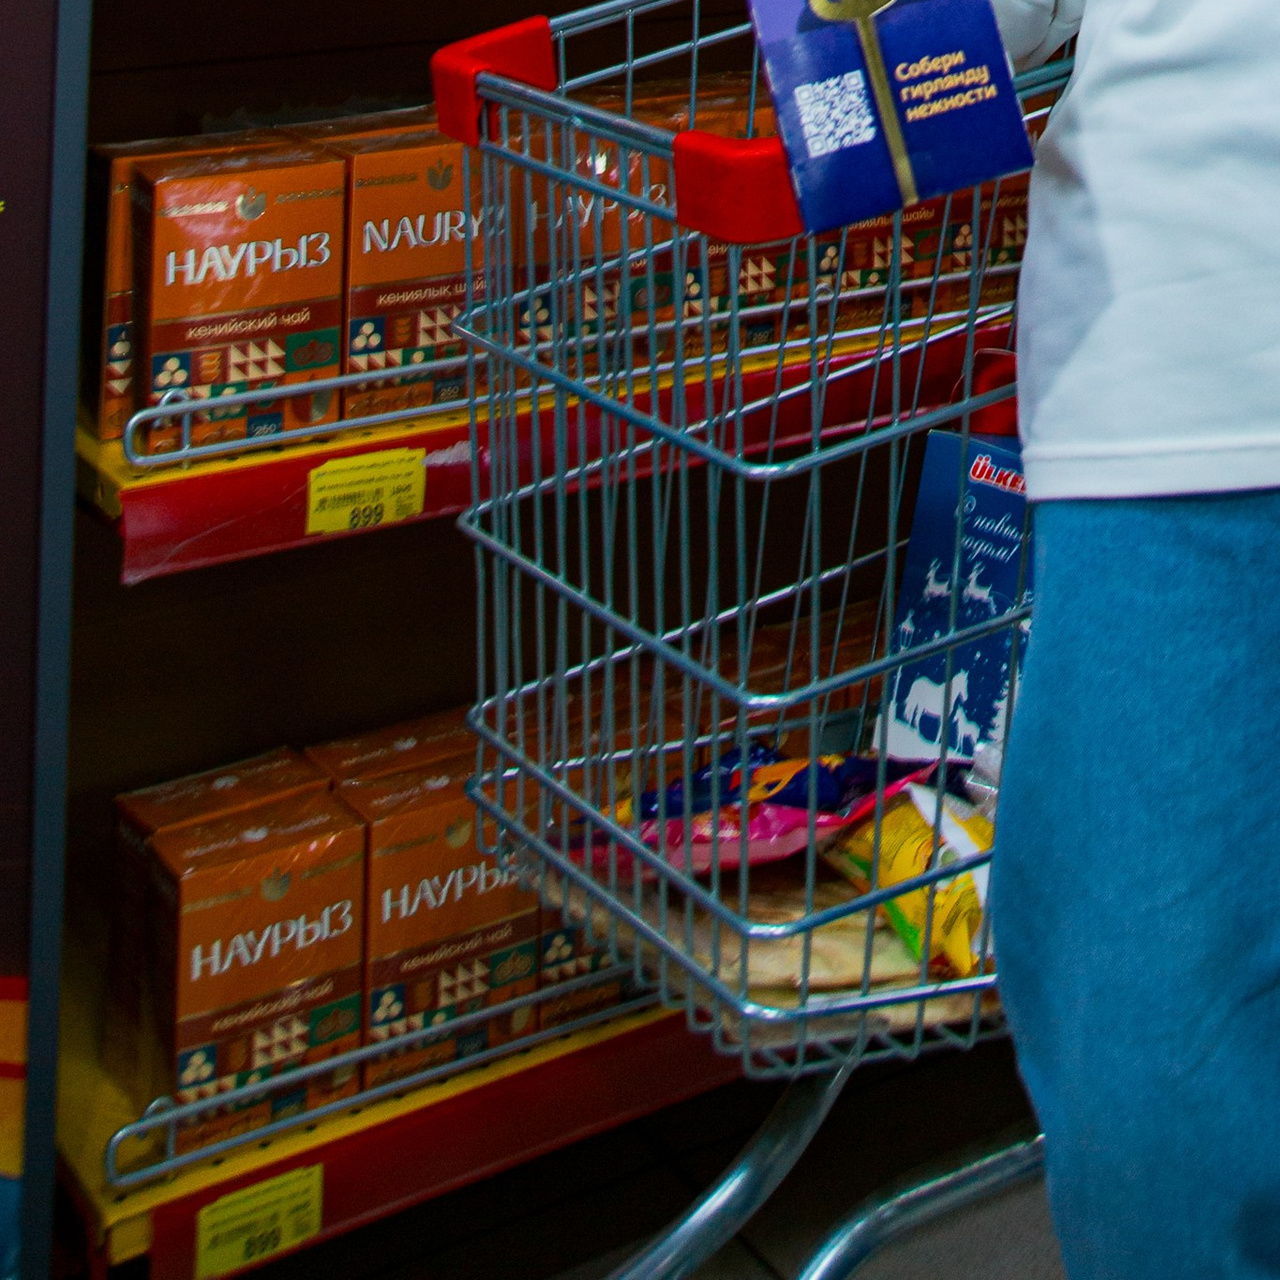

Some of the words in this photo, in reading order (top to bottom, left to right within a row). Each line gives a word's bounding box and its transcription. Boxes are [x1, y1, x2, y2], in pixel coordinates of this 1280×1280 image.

[894, 49, 966, 82] Собери
[900, 64, 991, 103] гирлянду
[905, 83, 998, 124] нежности
[164, 231, 332, 287] НАУРЫЗ
[185, 312, 278, 342] кенийский
[281, 306, 312, 326] чай
[969, 454, 1026, 496] ÜLKE
[188, 899, 353, 983] НАУРЫЗ
